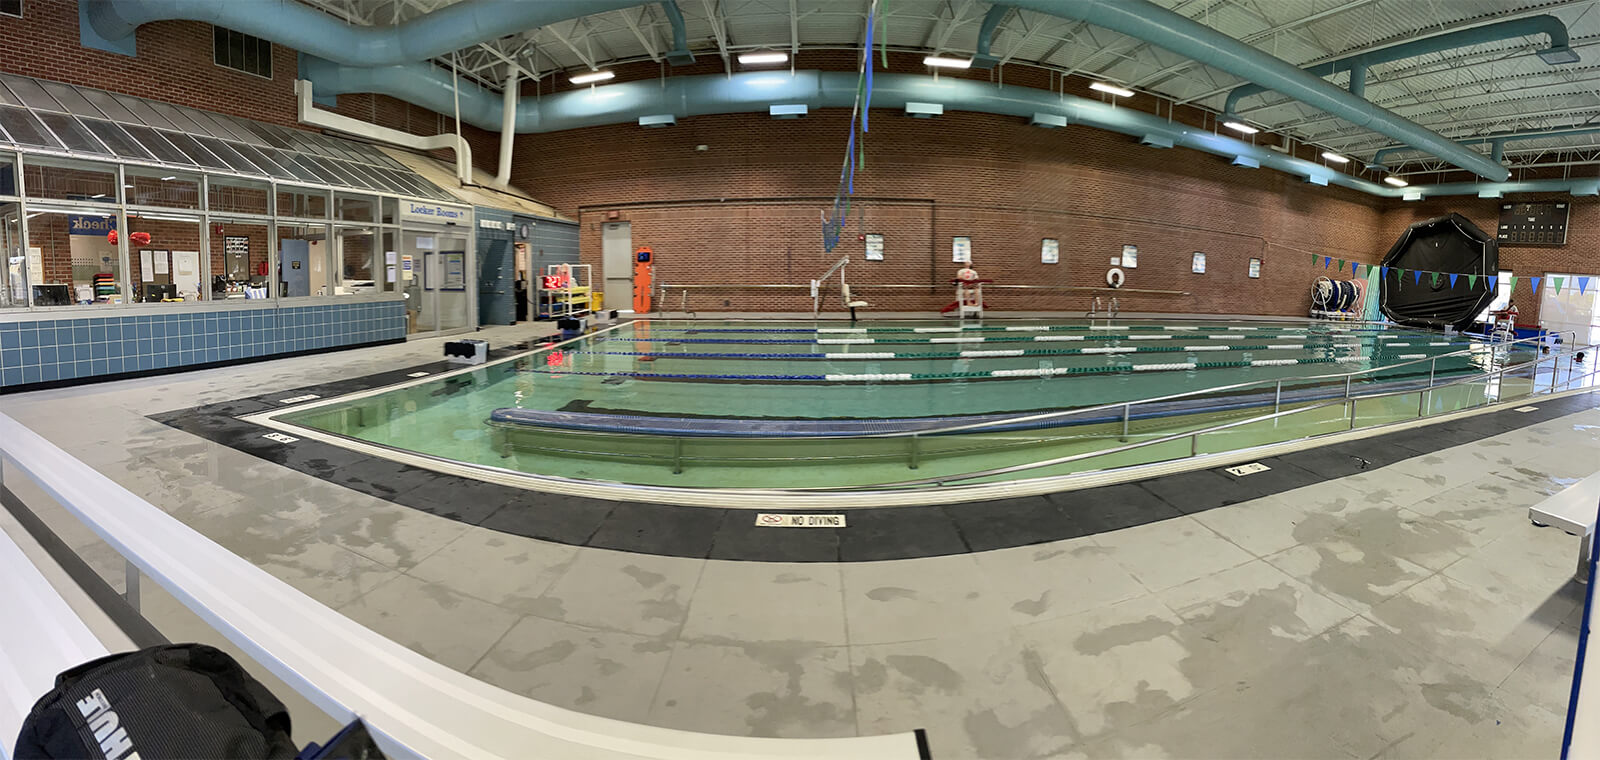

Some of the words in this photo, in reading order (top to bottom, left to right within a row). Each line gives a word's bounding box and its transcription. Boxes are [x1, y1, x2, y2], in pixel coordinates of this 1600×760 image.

[410, 203, 434, 215] Locker
[436, 207, 458, 218] Rooms
[792, 515, 804, 526] NO
[808, 515, 840, 526] DIVING
[76, 688, 142, 760] HULE
